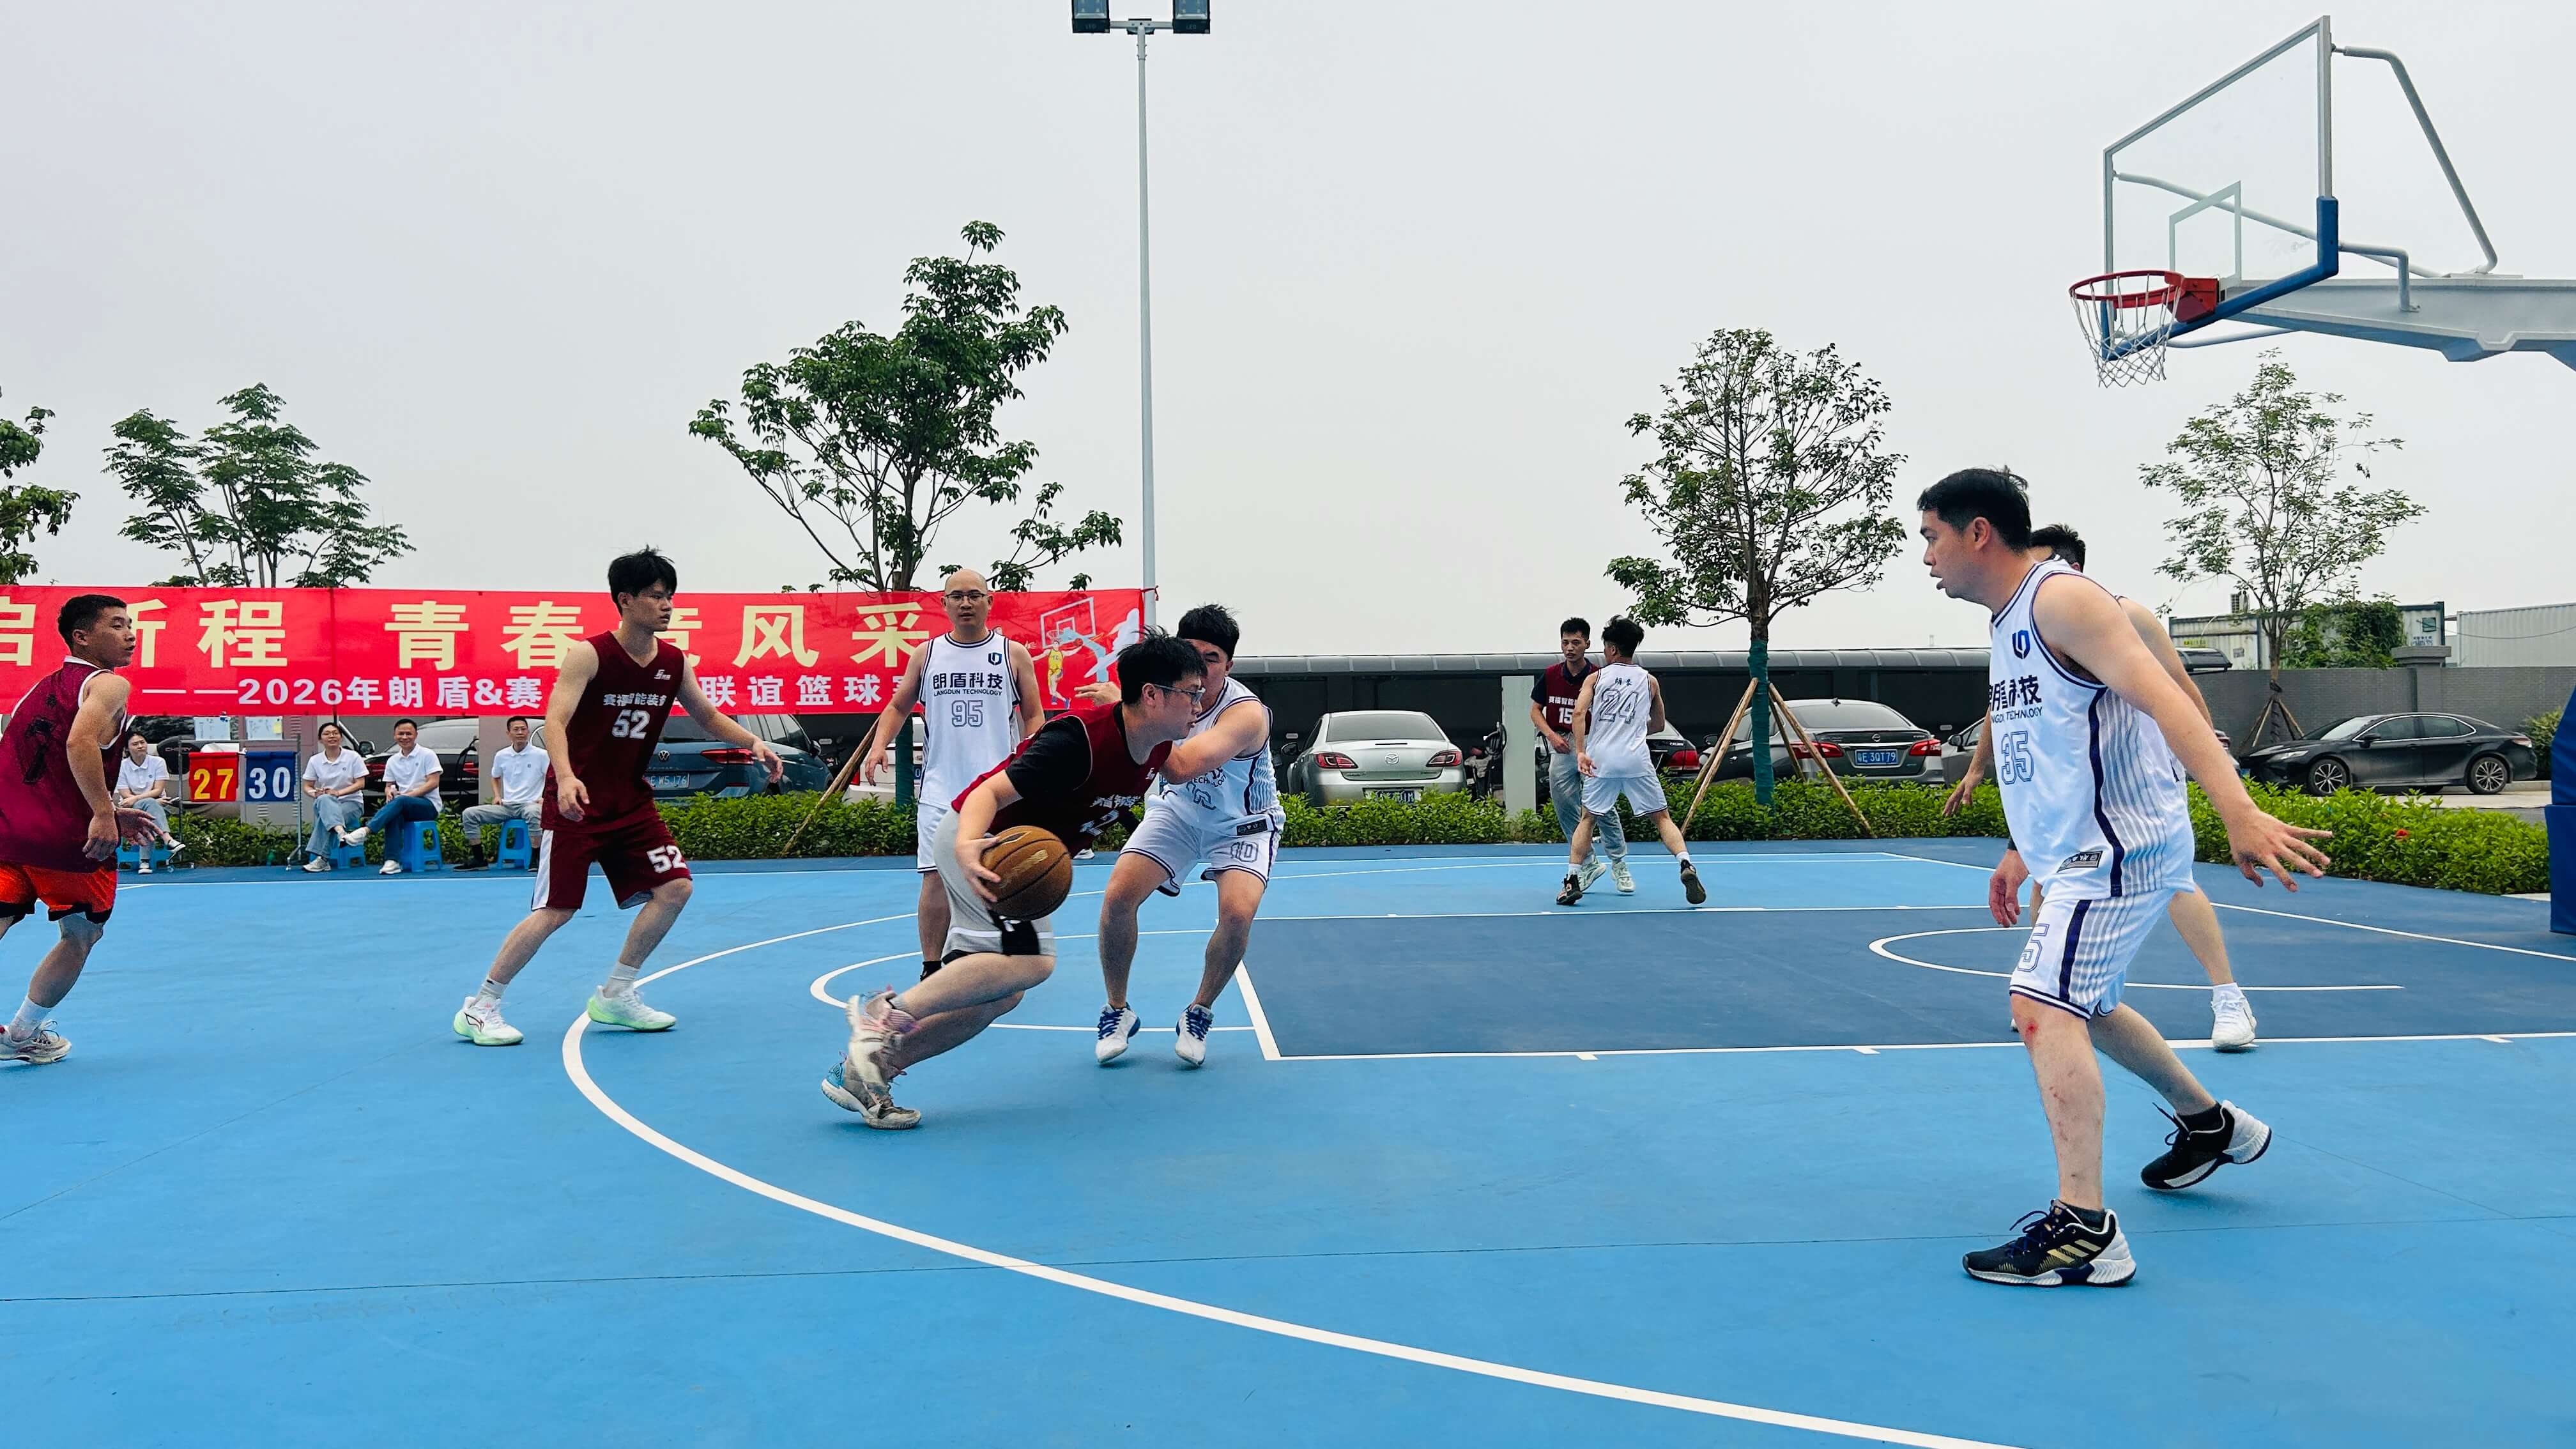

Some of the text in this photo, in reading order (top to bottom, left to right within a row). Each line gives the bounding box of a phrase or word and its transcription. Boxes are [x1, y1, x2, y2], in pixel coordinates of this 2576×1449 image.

[699, 674, 904, 707] 联谊篮球
[933, 673, 1003, 690] 朗盾科技
[963, 688, 1003, 696] TECHNOLOGY
[951, 700, 983, 728] 95
[1559, 707, 1574, 724] 15
[1599, 688, 1639, 724] 24
[611, 709, 650, 740] 52
[194, 769, 234, 800] 27
[249, 767, 291, 799] 30
[647, 845, 688, 874] 52
